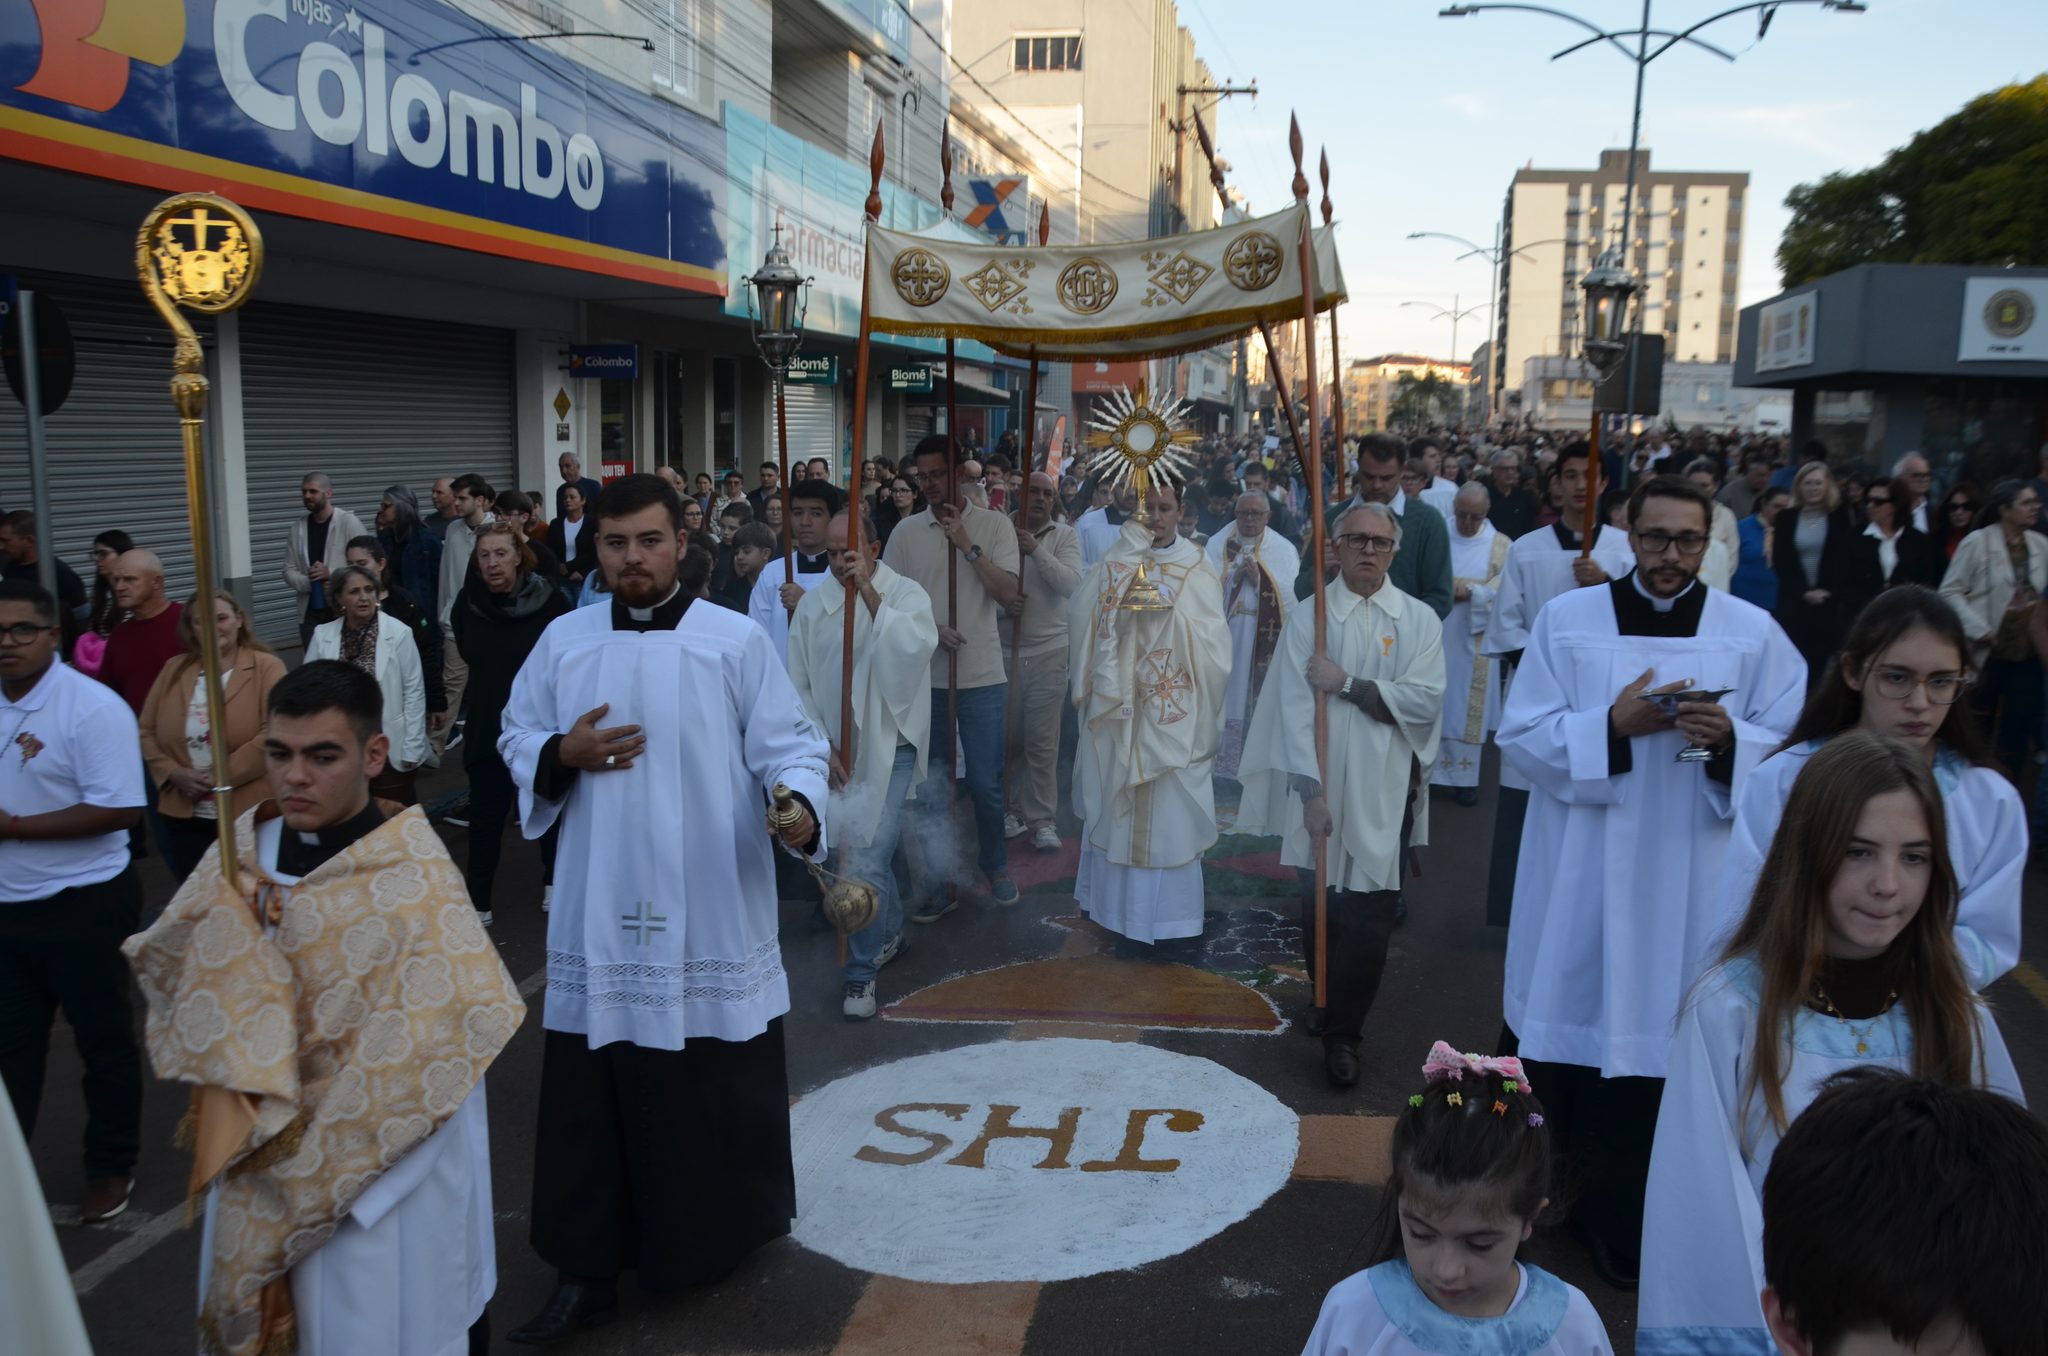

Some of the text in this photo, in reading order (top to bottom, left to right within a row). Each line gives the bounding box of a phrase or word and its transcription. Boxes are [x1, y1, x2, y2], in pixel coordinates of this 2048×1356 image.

[212, 0, 605, 212] Colombo
[585, 355, 633, 367] Colombo
[614, 464, 626, 477] TEM
